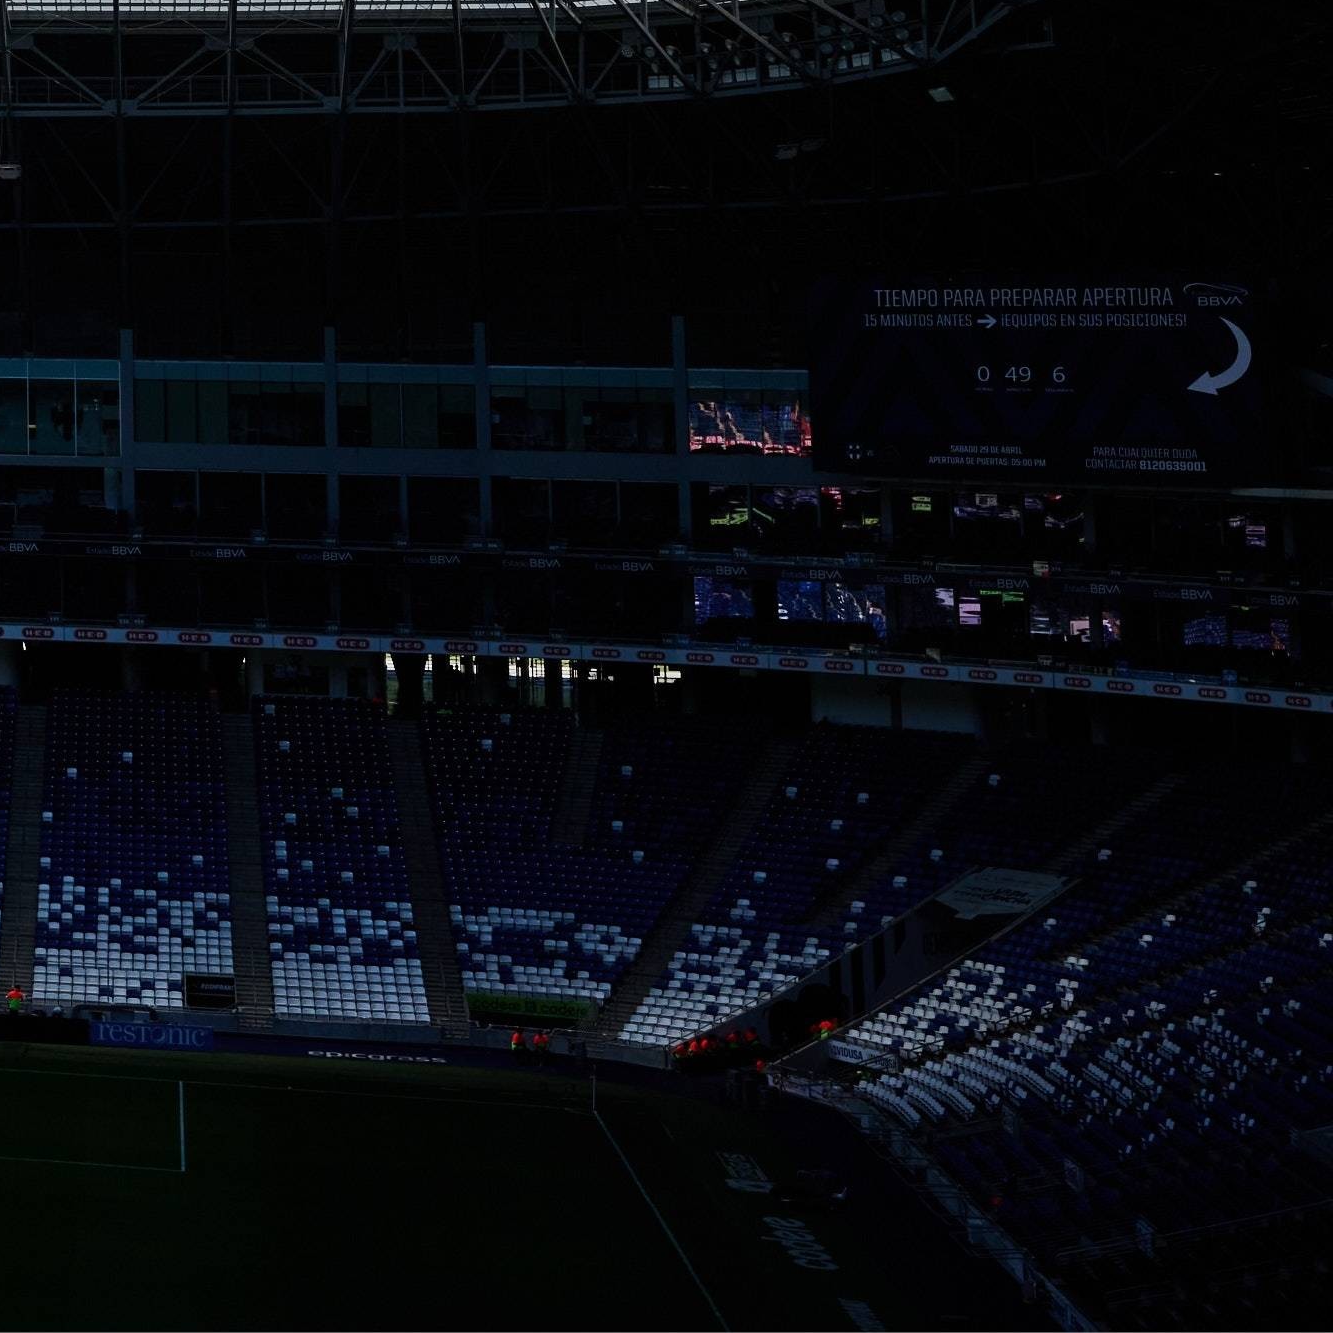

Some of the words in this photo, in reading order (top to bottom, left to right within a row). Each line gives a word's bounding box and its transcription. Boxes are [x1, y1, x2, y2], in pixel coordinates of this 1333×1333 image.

[874, 289, 938, 307] TIEMPO
[944, 289, 986, 307] PARA
[990, 288, 1077, 306] PREPARAR
[1082, 287, 1174, 306] APERTURA
[1197, 296, 1243, 306] BBVA
[864, 313, 877, 327] 15
[880, 313, 933, 327] MINUTOS
[936, 313, 972, 327] ANTES
[1060, 313, 1076, 327] EN
[1078, 313, 1102, 327] SUS
[1106, 313, 1187, 328] POSICIONES!
[1004, 366, 1031, 382] 49
[1052, 366, 1066, 383] 6
[1093, 446, 1116, 457] PARA
[1118, 447, 1170, 458] CUALQUIER
[1172, 448, 1198, 459] DUDA
[928, 456, 965, 465] APERTURA
[1085, 458, 1138, 469] CONTACTAR
[1139, 460, 1207, 471] 8120639001
[216, 549, 246, 558] BBVA
[622, 562, 654, 571] BBVA
[1180, 589, 1213, 600] BBVA
[308, 1050, 447, 1063] epicgrass
